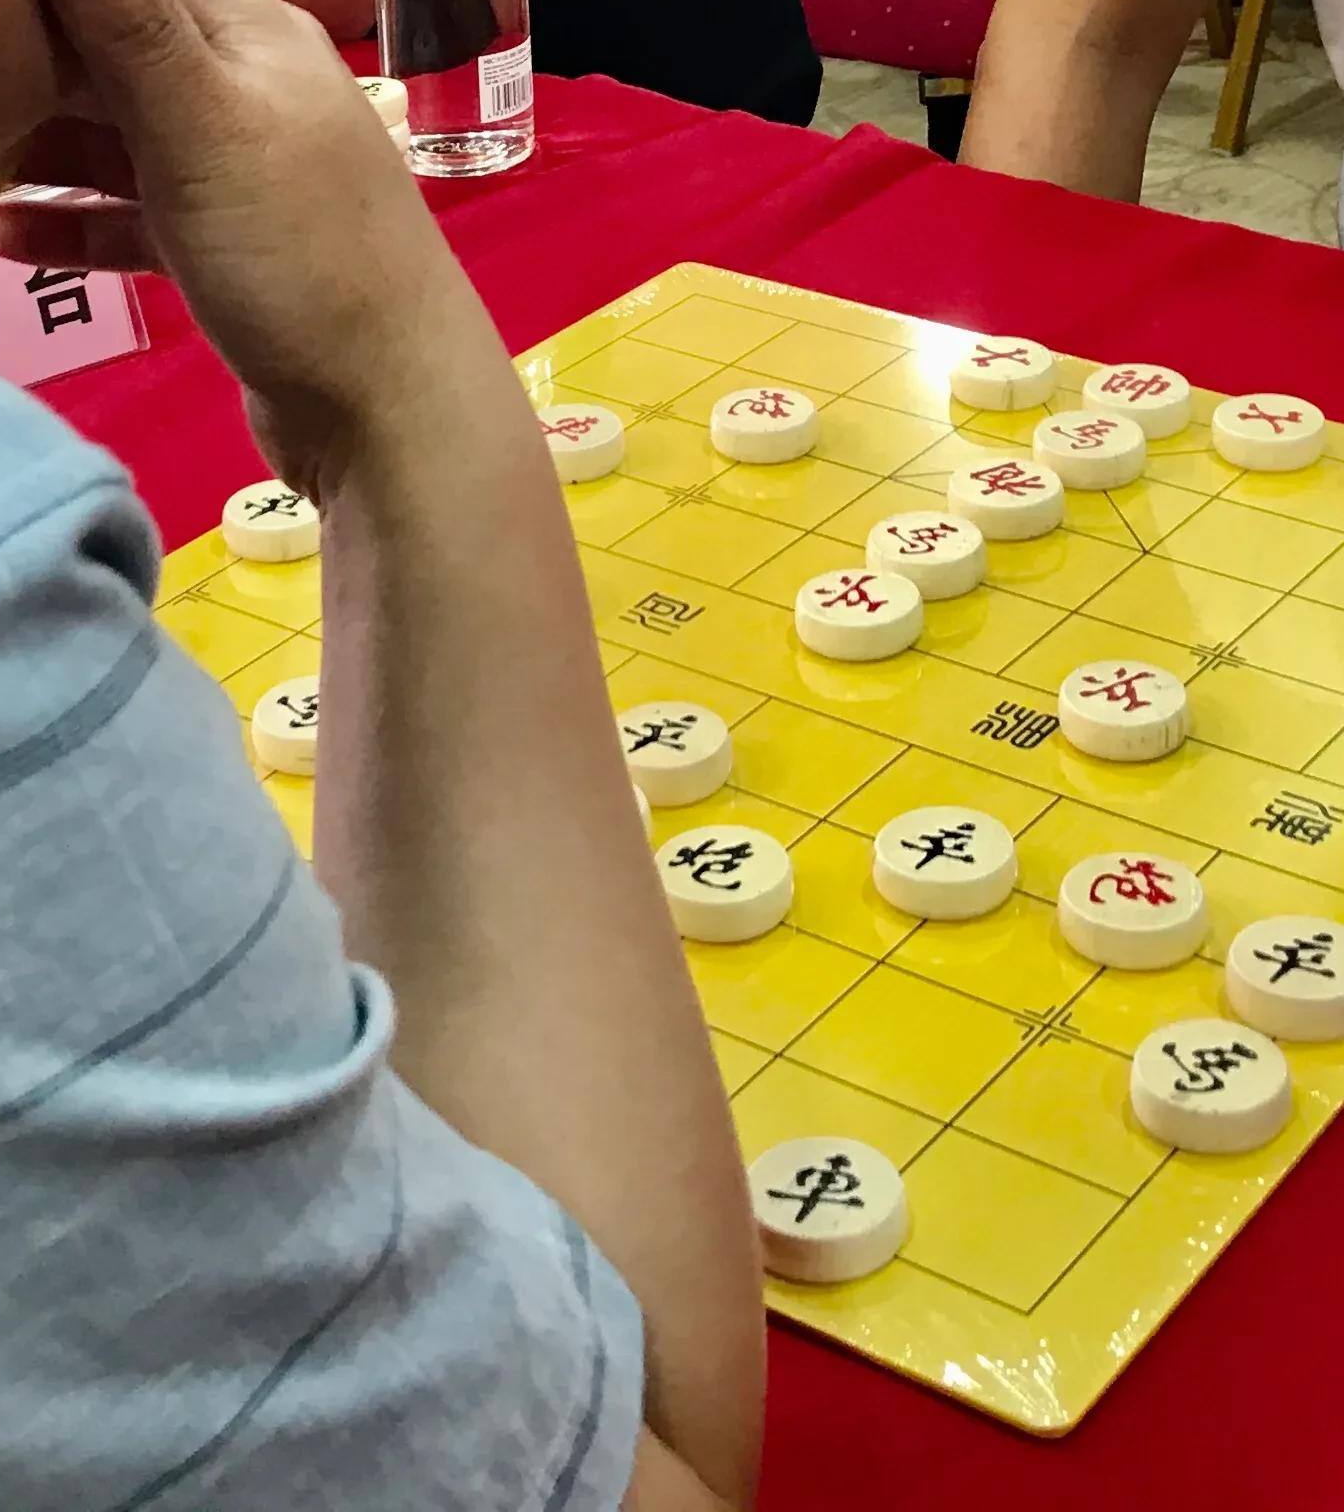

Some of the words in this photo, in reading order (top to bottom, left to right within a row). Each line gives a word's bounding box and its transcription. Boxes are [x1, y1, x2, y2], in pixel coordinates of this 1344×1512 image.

[1051, 421, 1115, 451] 馬
[888, 524, 957, 555] 馬
[816, 576, 887, 613] 兵
[1081, 669, 1156, 711] 兵
[623, 714, 698, 754] 卒
[900, 822, 976, 870] 卒
[1253, 933, 1336, 983] 卒
[1161, 1041, 1259, 1094] 馬
[766, 1153, 865, 1224] 車
